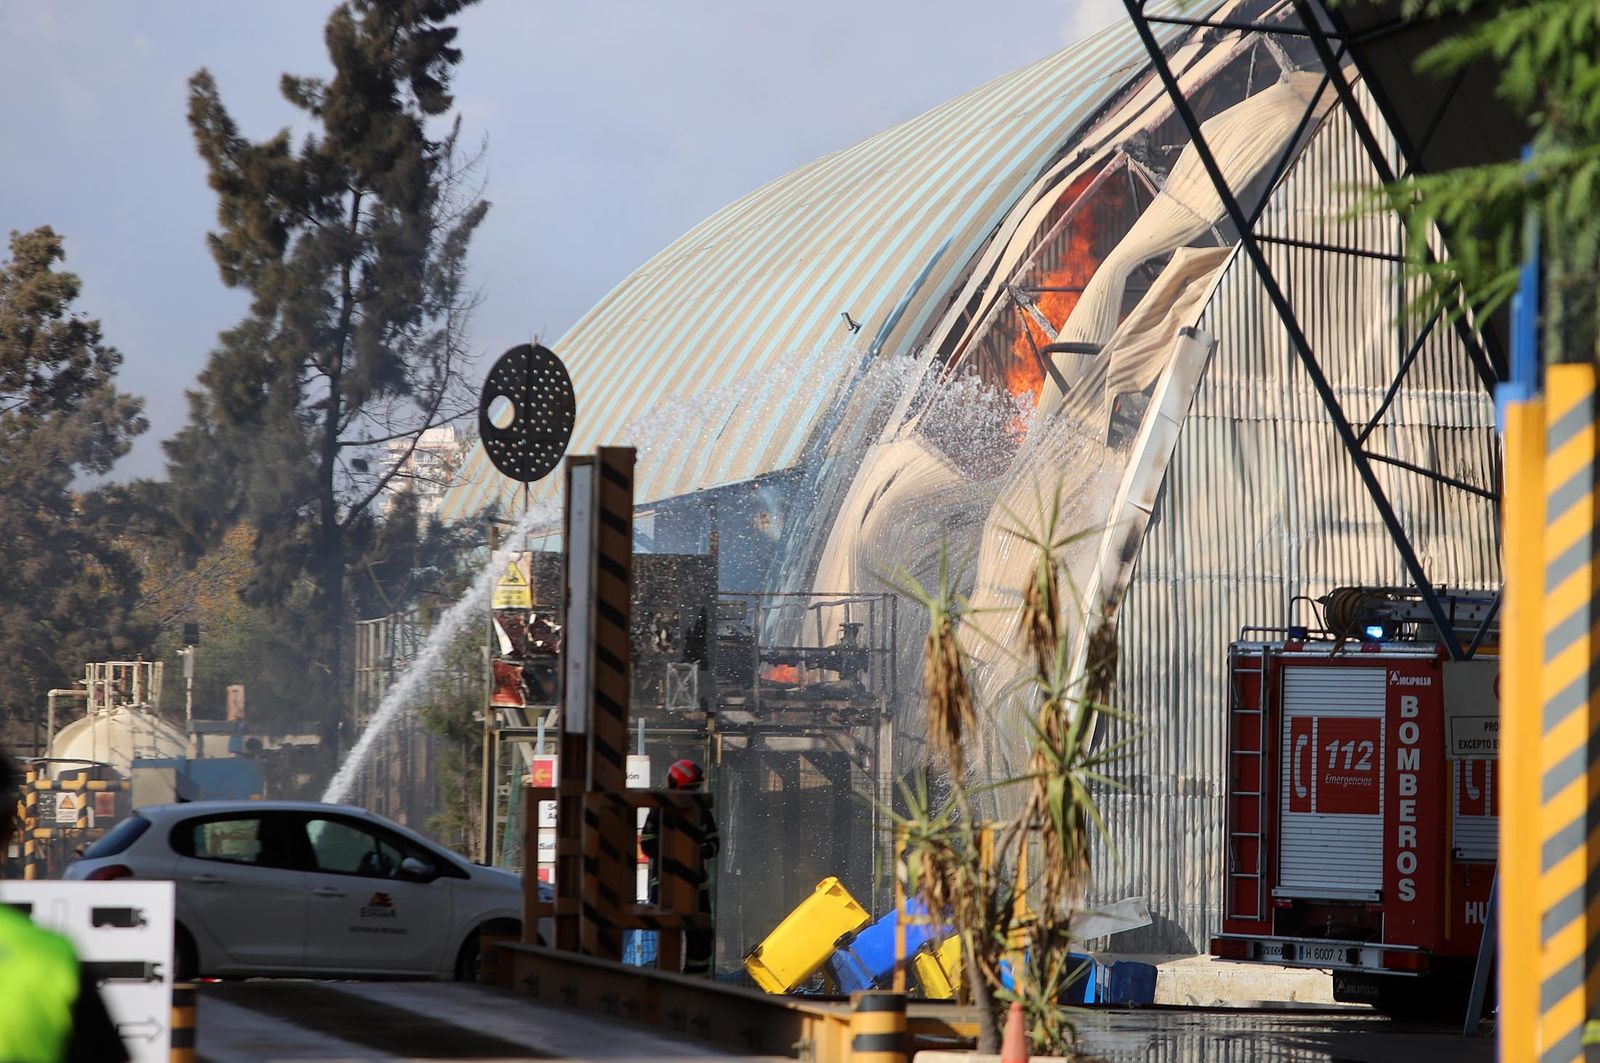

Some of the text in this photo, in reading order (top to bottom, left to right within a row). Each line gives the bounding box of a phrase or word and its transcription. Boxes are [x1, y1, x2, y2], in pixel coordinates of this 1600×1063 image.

[1459, 740, 1492, 750] EXCEPTO
[1325, 739, 1374, 770] 112
[1325, 773, 1373, 787] Emergencias
[1396, 695, 1420, 902] BOMBEROS
[1305, 948, 1344, 961] H 6007 Z
